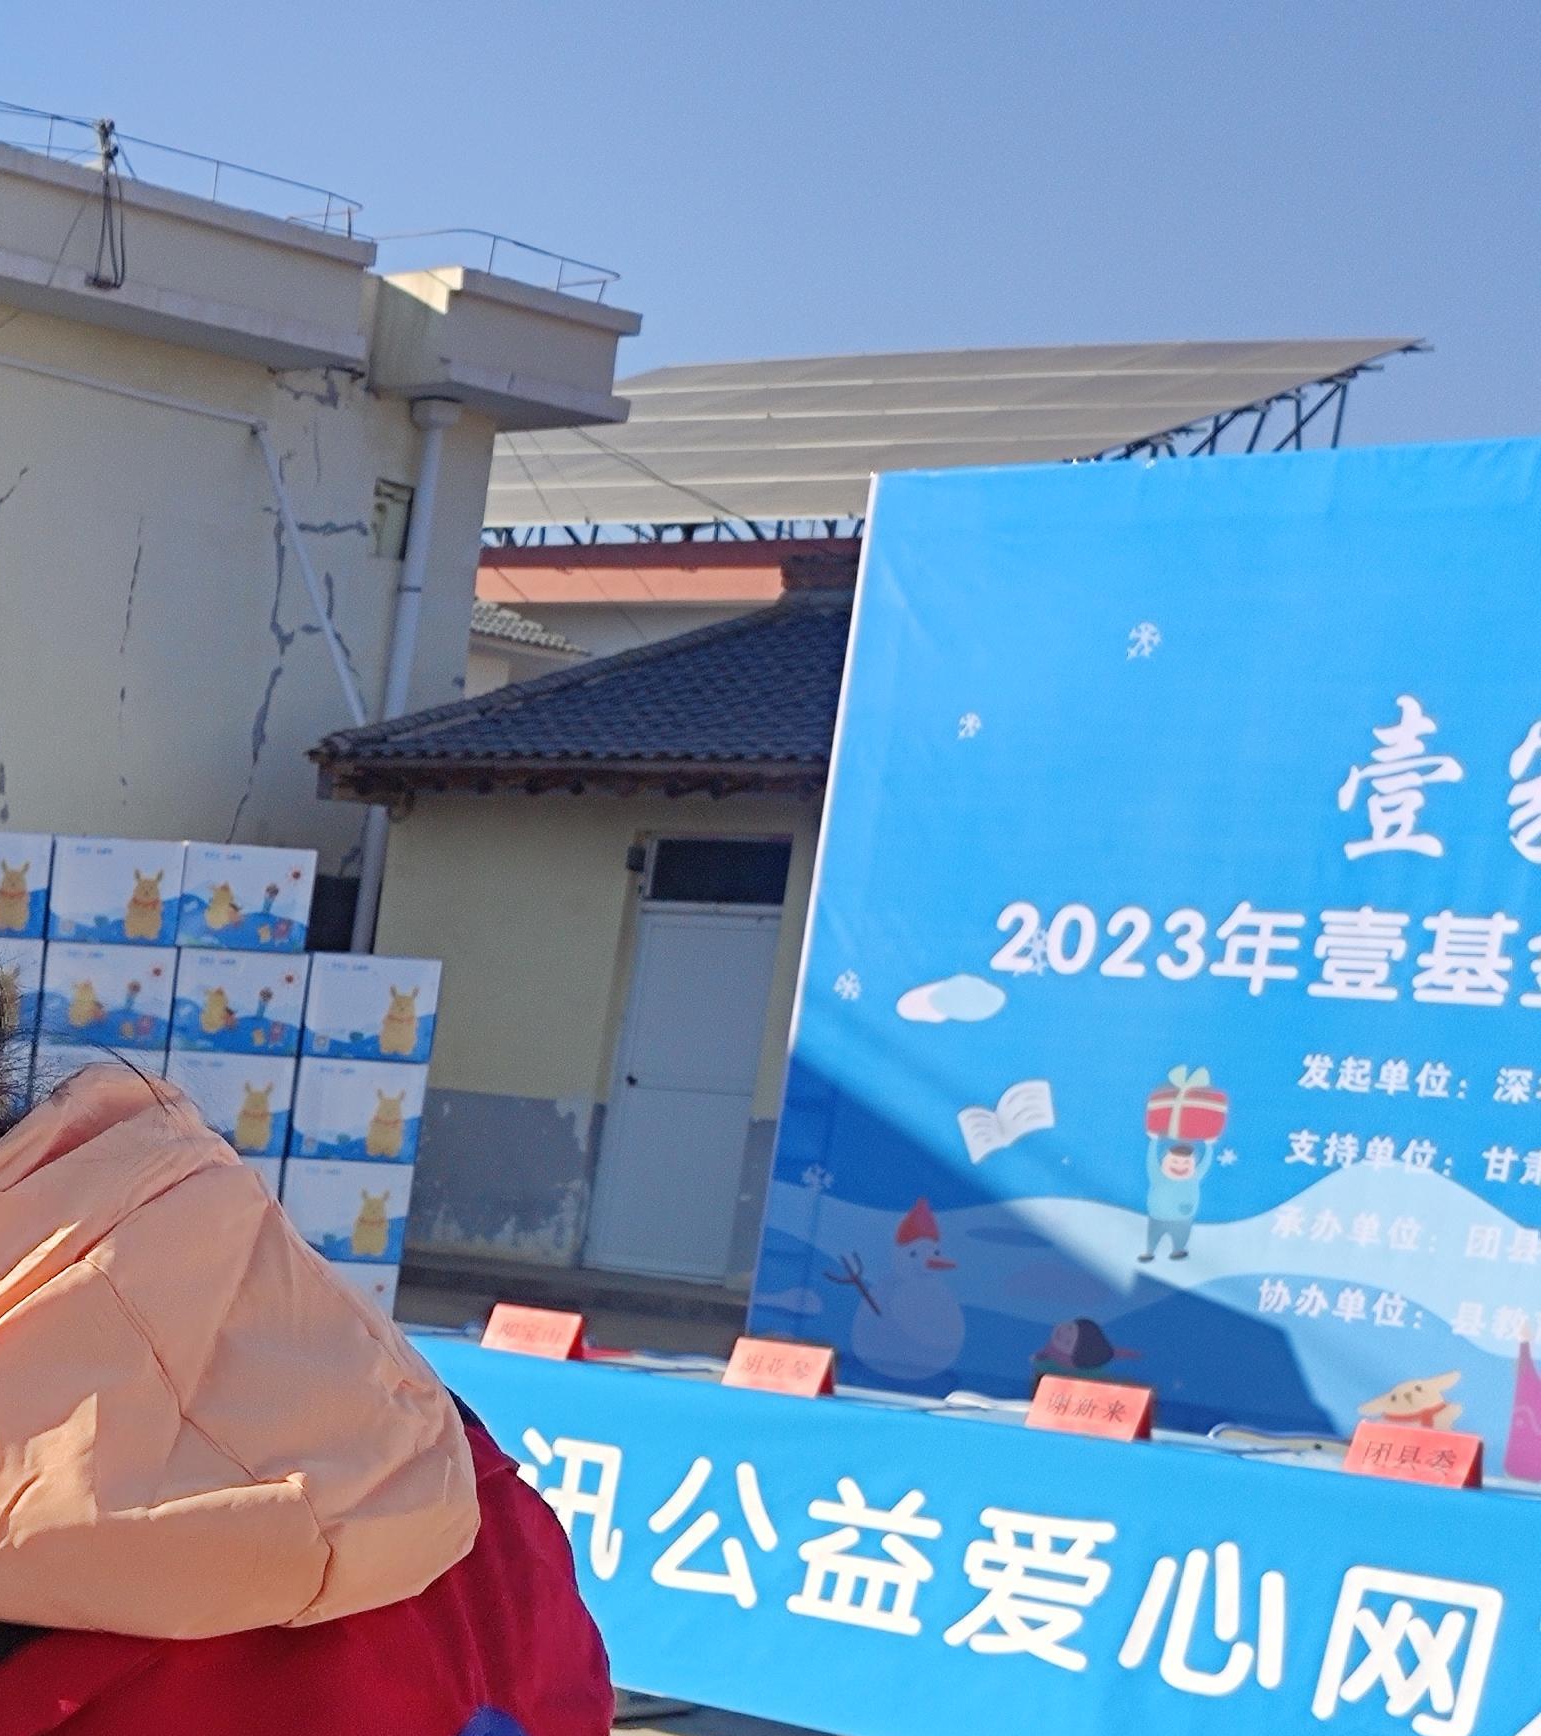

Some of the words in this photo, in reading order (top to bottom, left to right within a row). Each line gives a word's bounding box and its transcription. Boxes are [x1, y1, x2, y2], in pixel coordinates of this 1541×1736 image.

[1337, 694, 1541, 866] 壹
[990, 900, 1541, 1008] 2023年壹基
[1297, 1053, 1541, 1105] 发起单位：深
